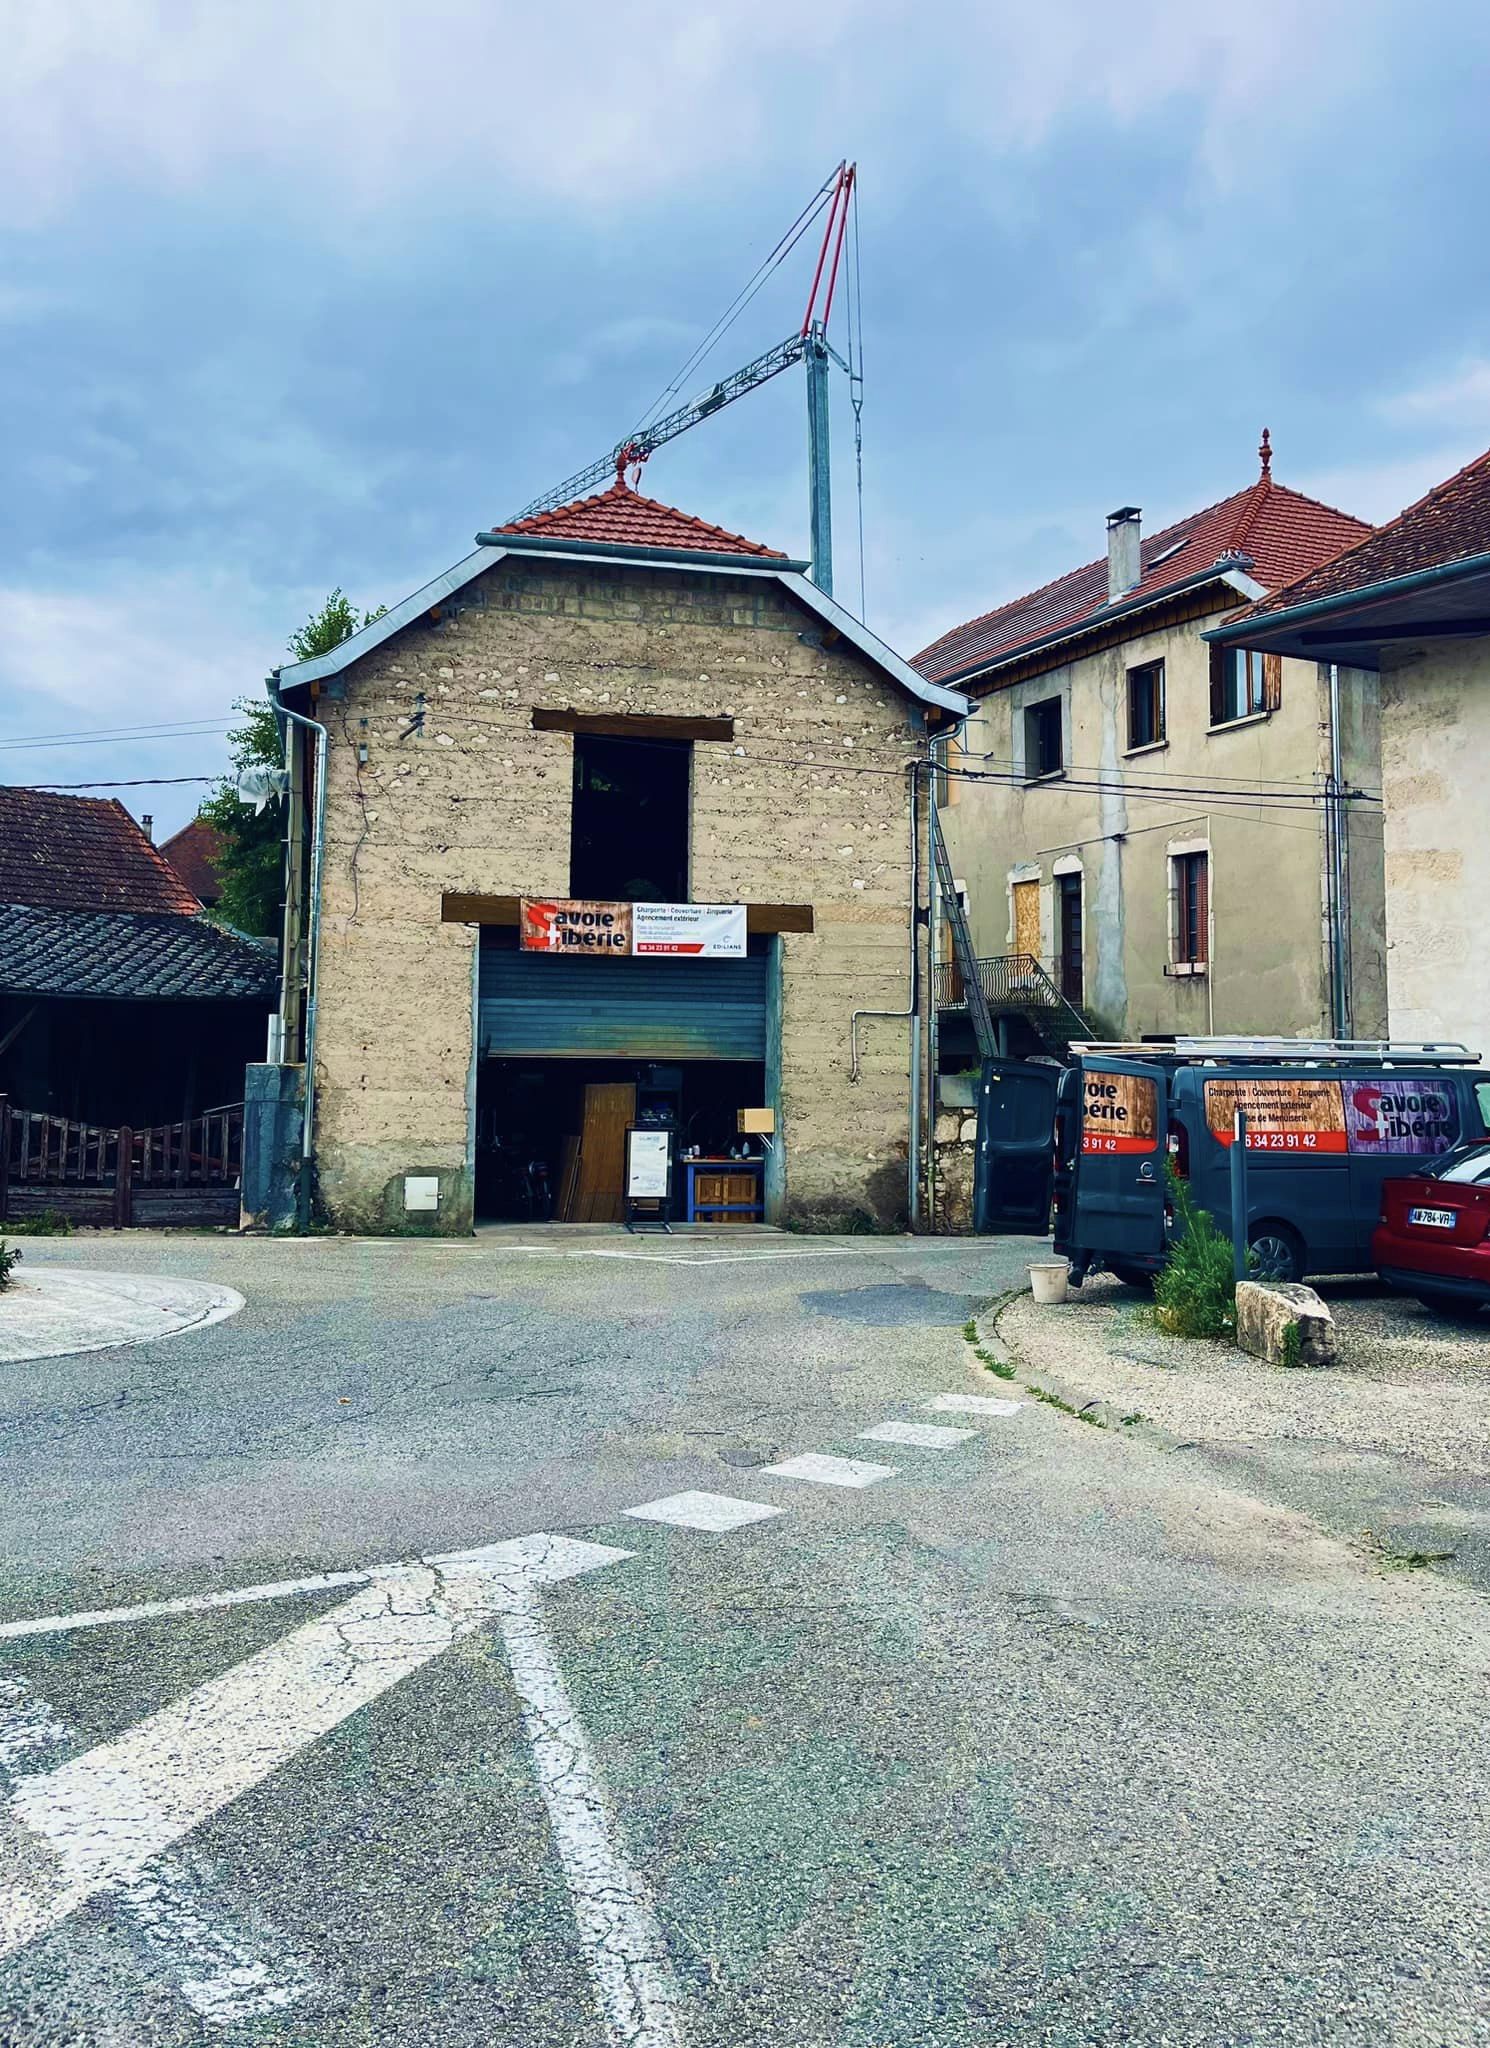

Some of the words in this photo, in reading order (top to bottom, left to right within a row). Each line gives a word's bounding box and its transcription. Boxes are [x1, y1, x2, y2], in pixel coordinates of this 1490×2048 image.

[1208, 1087, 1247, 1098] Charpente
[1252, 1087, 1292, 1097] Couverture
[1297, 1087, 1330, 1098] Zinguerie
[1233, 1100, 1279, 1111] Agencement
[1268, 1112, 1308, 1122] Menuiserie
[1091, 1138, 1102, 1149] 91
[1104, 1139, 1117, 1151] 42
[1254, 1134, 1268, 1147] 34
[1270, 1134, 1284, 1147] 23
[1286, 1134, 1299, 1147] 91
[1302, 1134, 1317, 1147] 42
